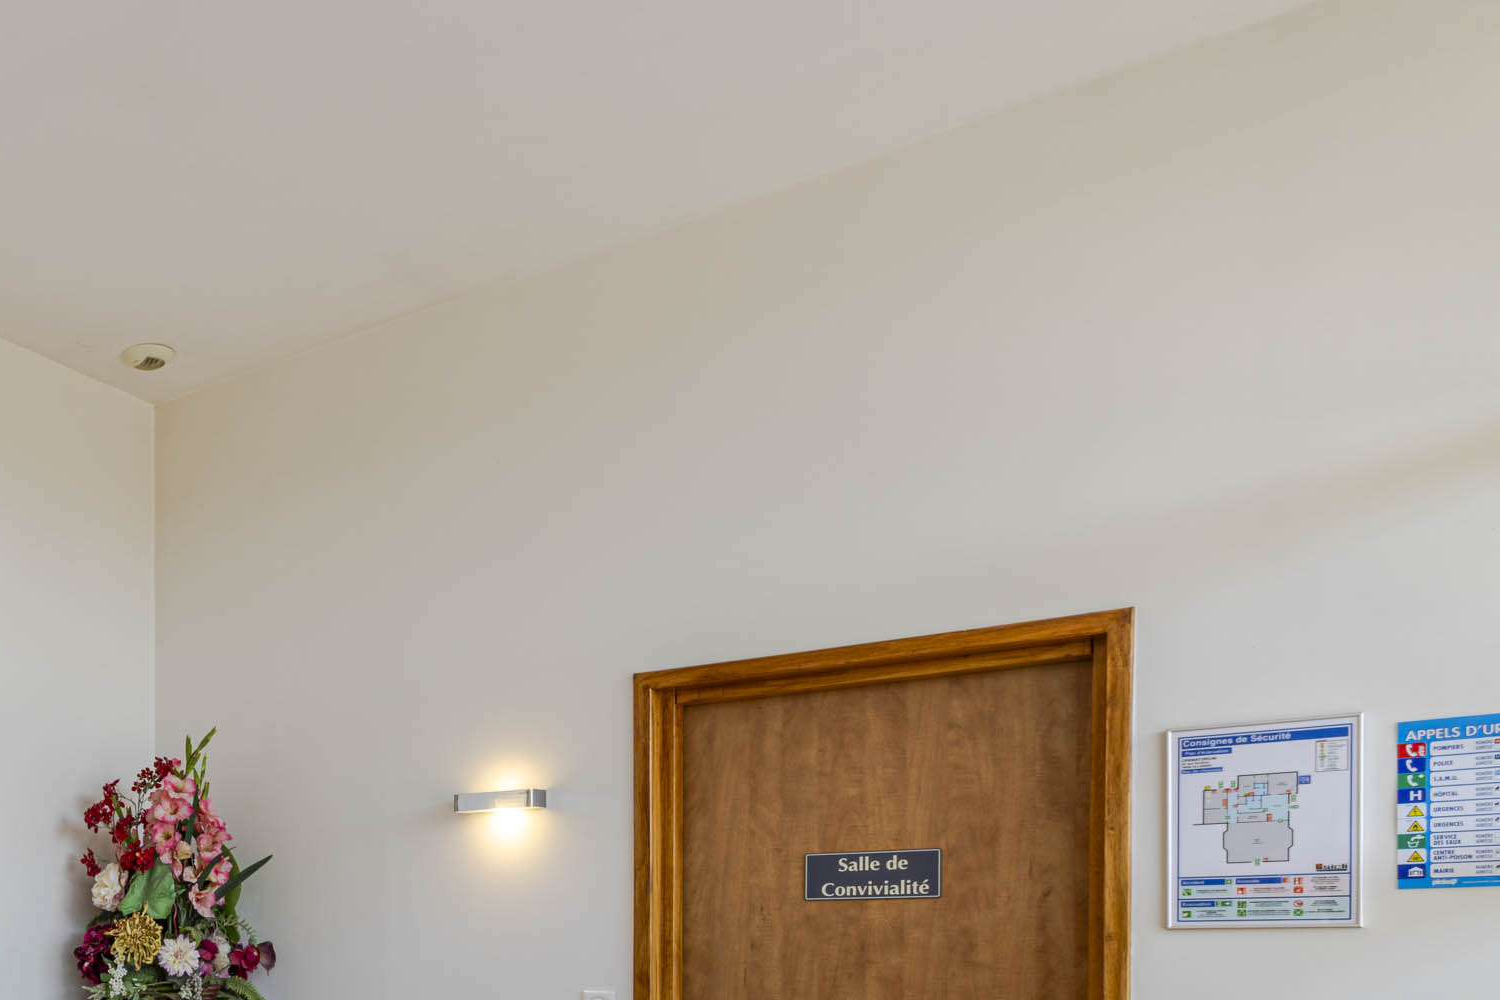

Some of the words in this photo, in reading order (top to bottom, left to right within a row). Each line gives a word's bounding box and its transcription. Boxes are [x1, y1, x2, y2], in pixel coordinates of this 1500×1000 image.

[1183, 736, 1233, 748] Consignes
[1236, 735, 1248, 744] de
[1250, 732, 1292, 742] Sécurité
[1404, 726, 1461, 742] APPELS
[837, 855, 881, 872] Salle
[886, 855, 909, 870] de
[821, 878, 930, 897] Convivialité
